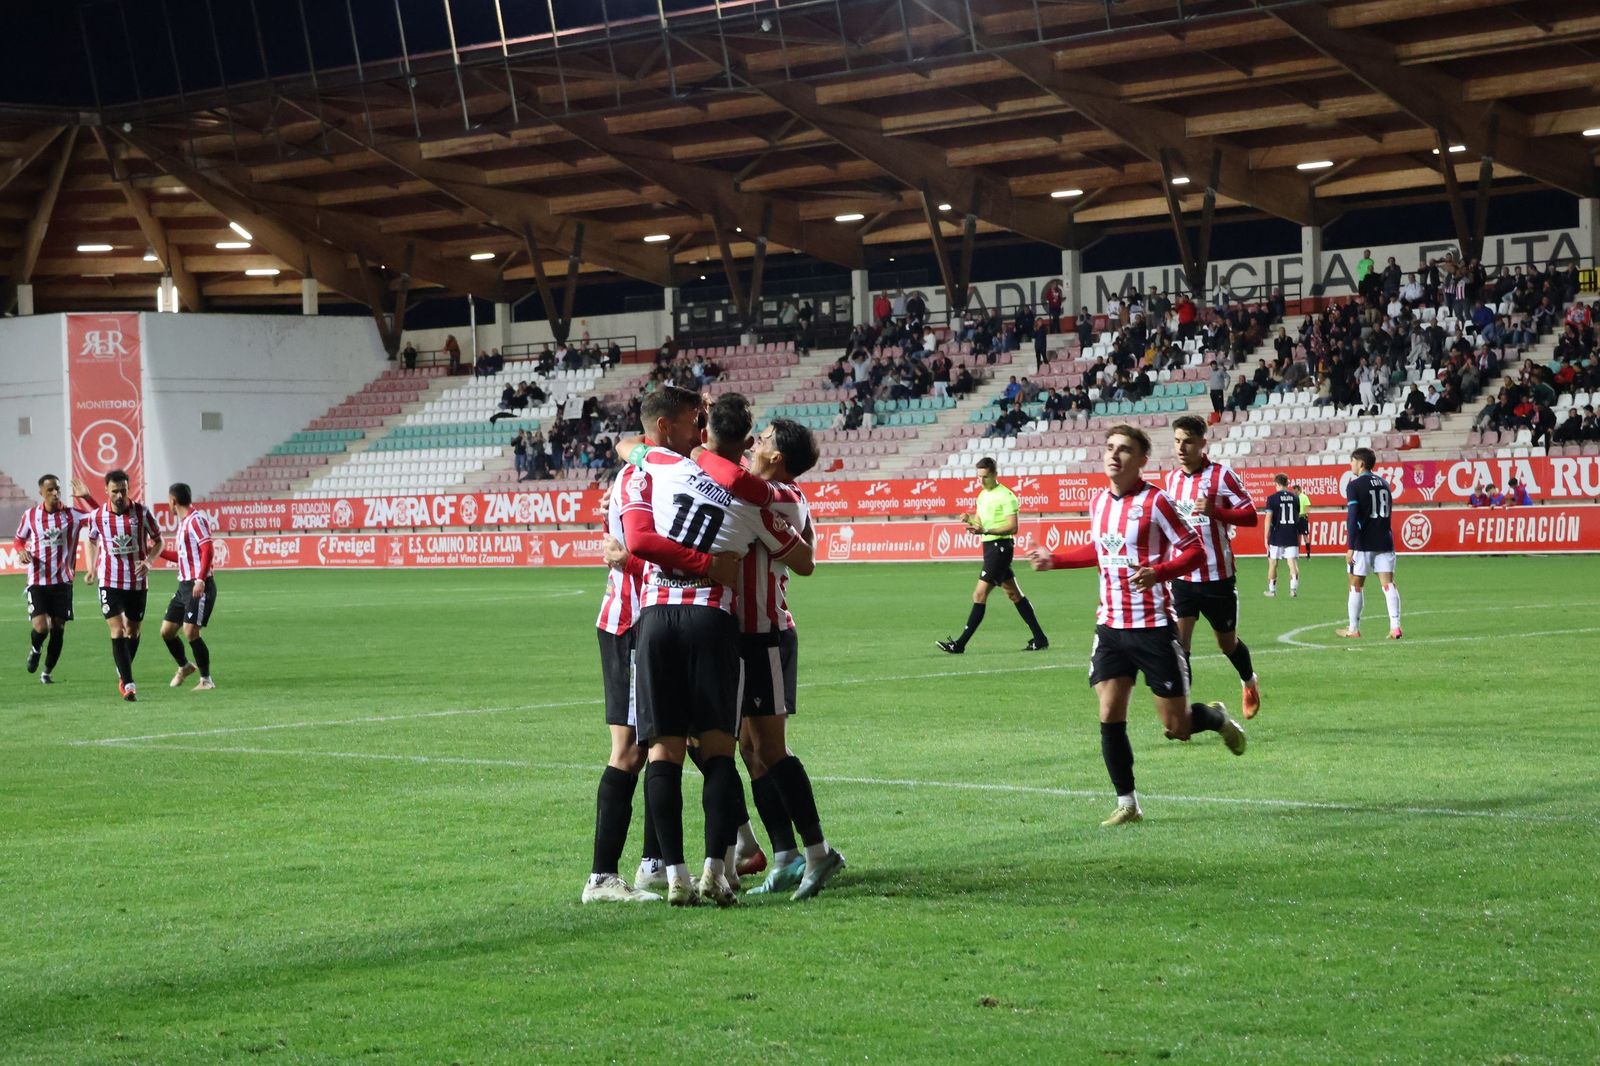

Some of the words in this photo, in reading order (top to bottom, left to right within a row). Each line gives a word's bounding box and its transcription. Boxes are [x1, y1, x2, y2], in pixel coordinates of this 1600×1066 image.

[76, 399, 136, 409] MONTETORO
[97, 432, 118, 464] 8
[1447, 458, 1541, 497] CAJA
[696, 481, 734, 507] RAMOS
[1327, 486, 1338, 494] DE
[221, 503, 286, 514] www.cubiex.es
[291, 502, 331, 514] FUNDACIÓN
[363, 497, 432, 527] ZAMORA
[432, 496, 457, 526] CF
[484, 493, 556, 524] ZAMORA
[556, 492, 583, 523] CF
[858, 498, 899, 511] sangregorio
[903, 497, 946, 510] sangregorio
[1279, 503, 1295, 524] 11
[1368, 489, 1391, 518] 18
[240, 518, 253, 528] 675
[254, 517, 267, 528] 630
[269, 517, 281, 528] 110
[667, 493, 725, 553] 10
[1458, 518, 1475, 543] 1ª
[1477, 512, 1580, 543] FEDERACIÓN
[254, 537, 300, 557] Freigel
[328, 536, 375, 557] Freigel
[408, 537, 424, 554] E.S.
[427, 536, 465, 553] CAMINO
[466, 536, 478, 552] DE
[480, 536, 492, 552] LA
[494, 535, 522, 552] PLATA
[852, 540, 926, 554] casqueriasusi.es
[416, 554, 445, 563] Morales
[447, 554, 458, 563] del
[460, 554, 477, 563] Vino
[478, 553, 515, 564] (Zamora)
